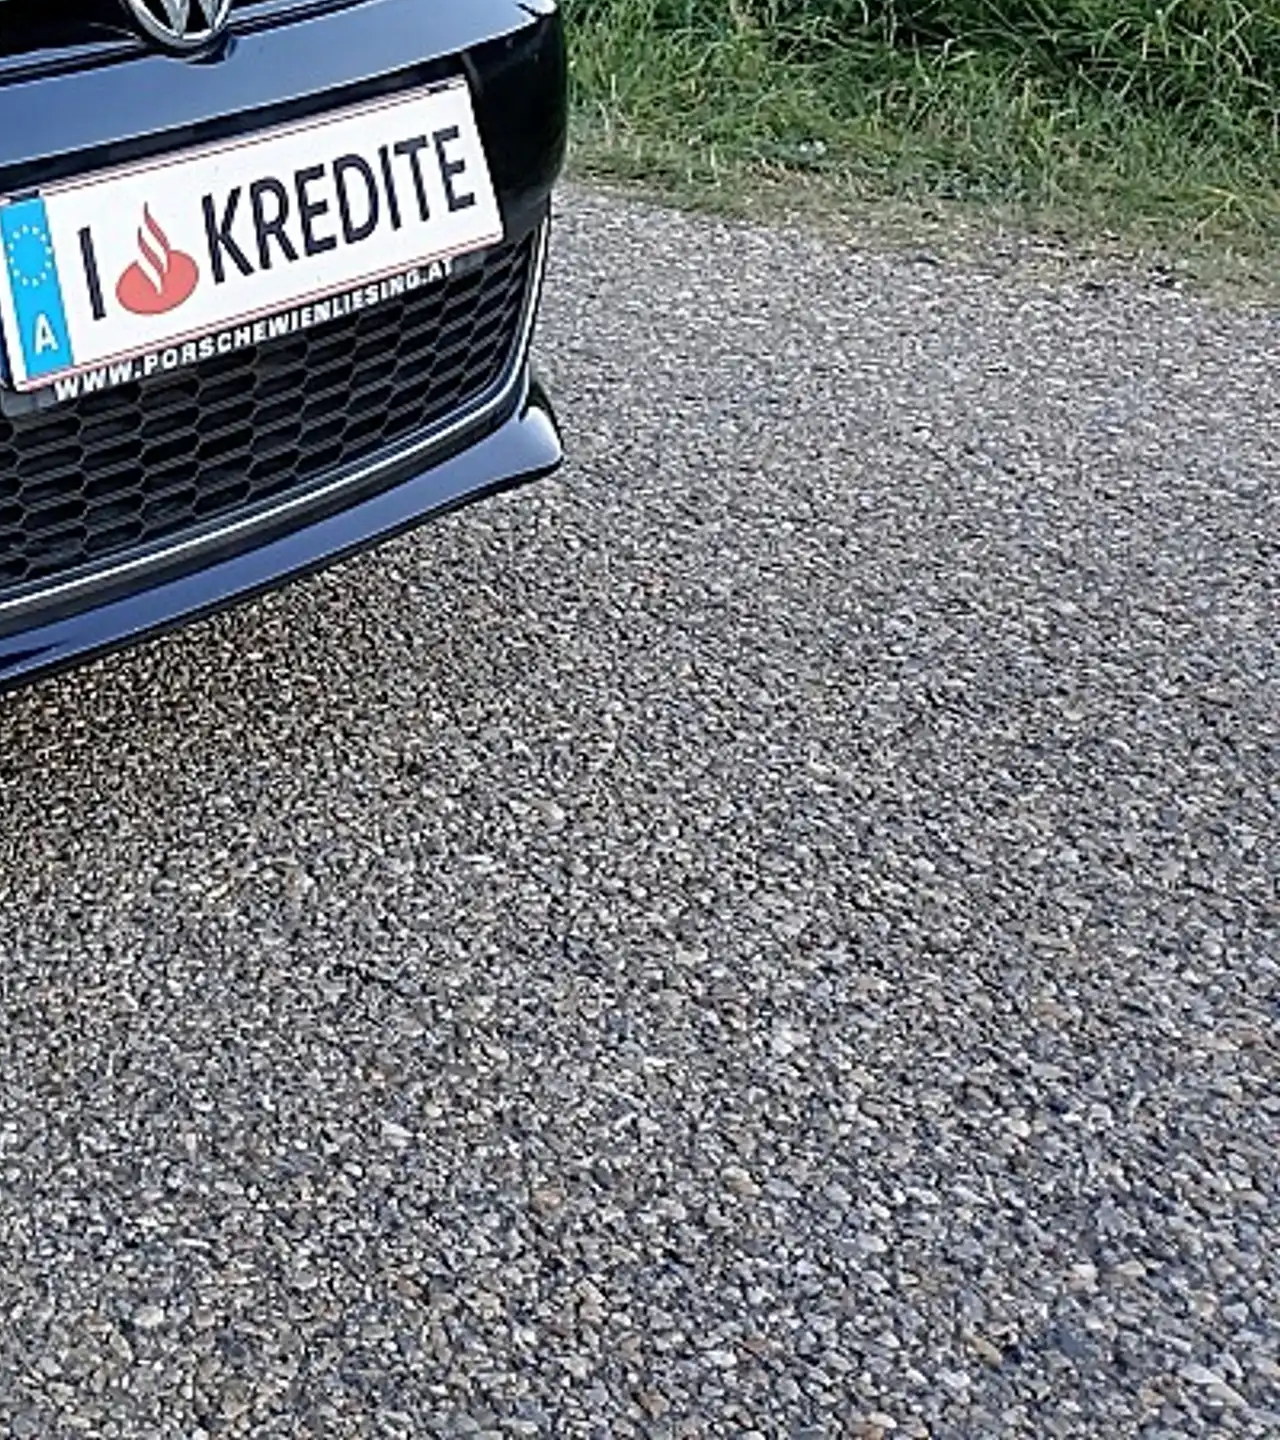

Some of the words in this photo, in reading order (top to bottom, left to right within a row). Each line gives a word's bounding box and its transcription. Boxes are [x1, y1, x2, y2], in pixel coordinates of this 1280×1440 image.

[78, 227, 106, 320] I
[202, 125, 476, 285] KREDITE
[34, 313, 58, 353] A
[54, 260, 454, 401] WWW.PORSCHEWIENLIESING.AT
